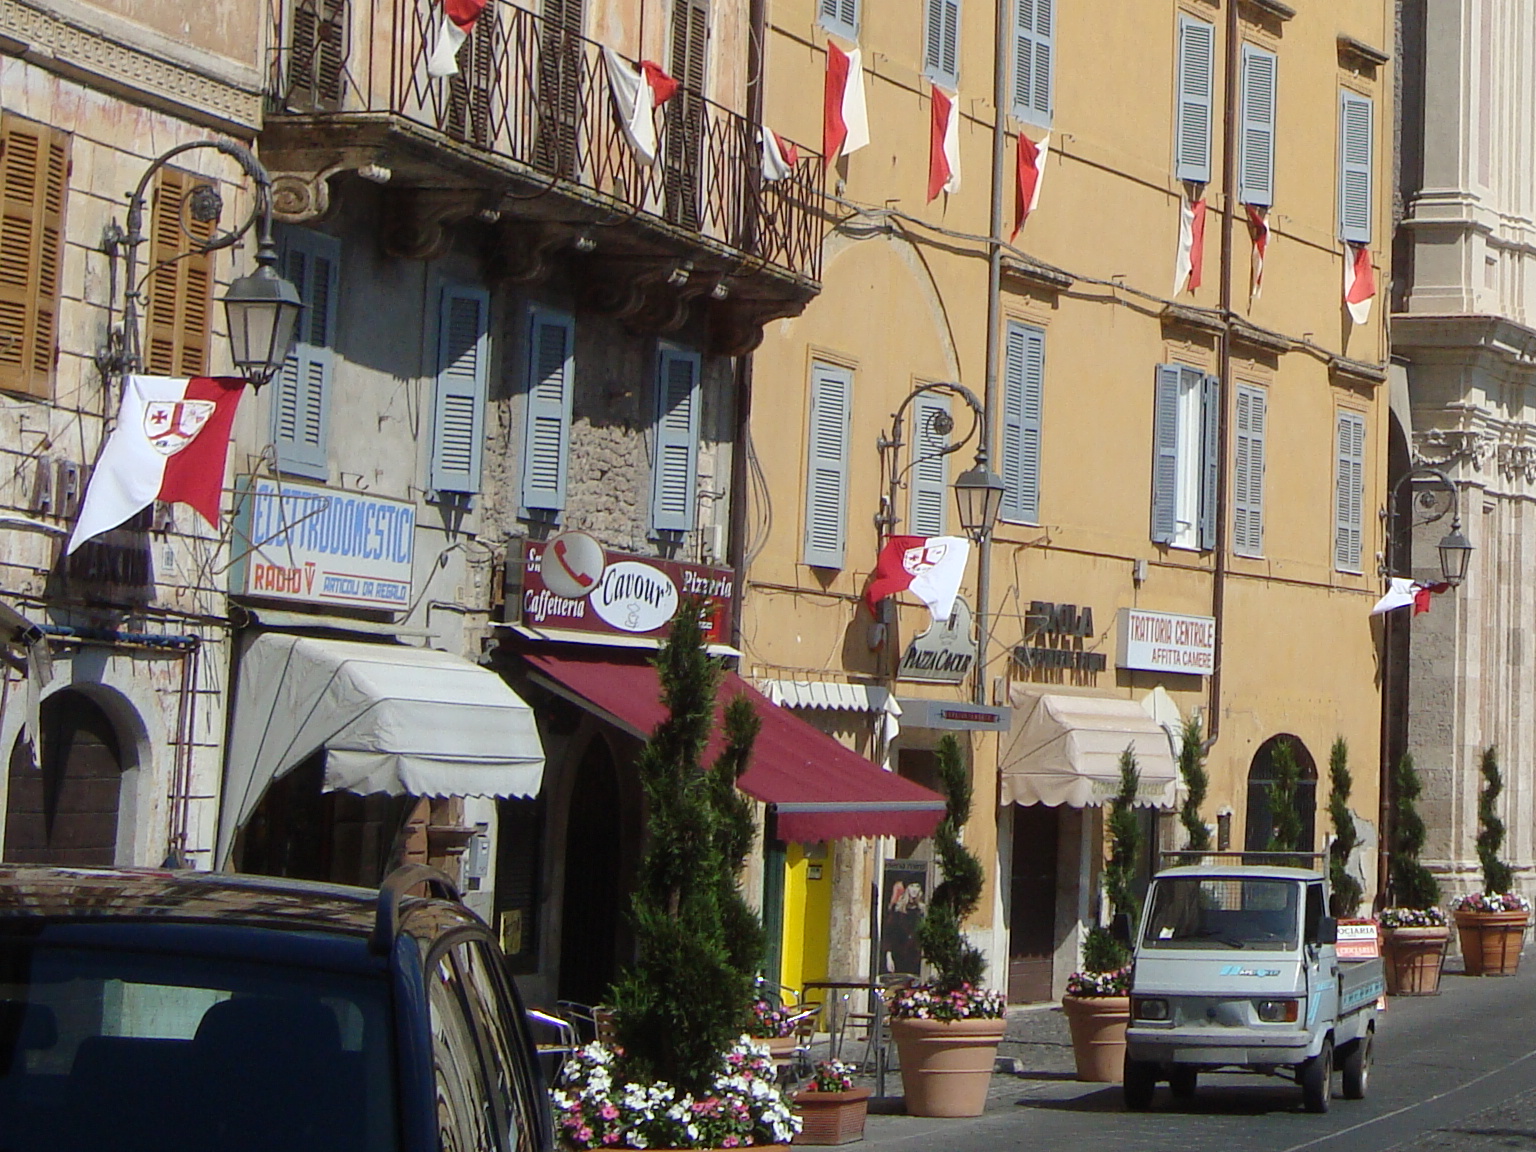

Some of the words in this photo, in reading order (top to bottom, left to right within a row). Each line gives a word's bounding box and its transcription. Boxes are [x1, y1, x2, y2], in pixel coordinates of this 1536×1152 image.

[254, 484, 414, 564] ELETTRODOMESTICI
[254, 563, 301, 594] RADIO
[323, 576, 360, 595] ARTICOLI
[362, 580, 373, 597] DA
[375, 583, 407, 600] REGALO
[524, 589, 585, 622] Caffetteria
[1130, 615, 1172, 645] TRATTORIA
[1175, 620, 1213, 648] CENTRALE
[1151, 648, 1181, 666] AFFITTA
[1182, 651, 1212, 669] CAMERE
